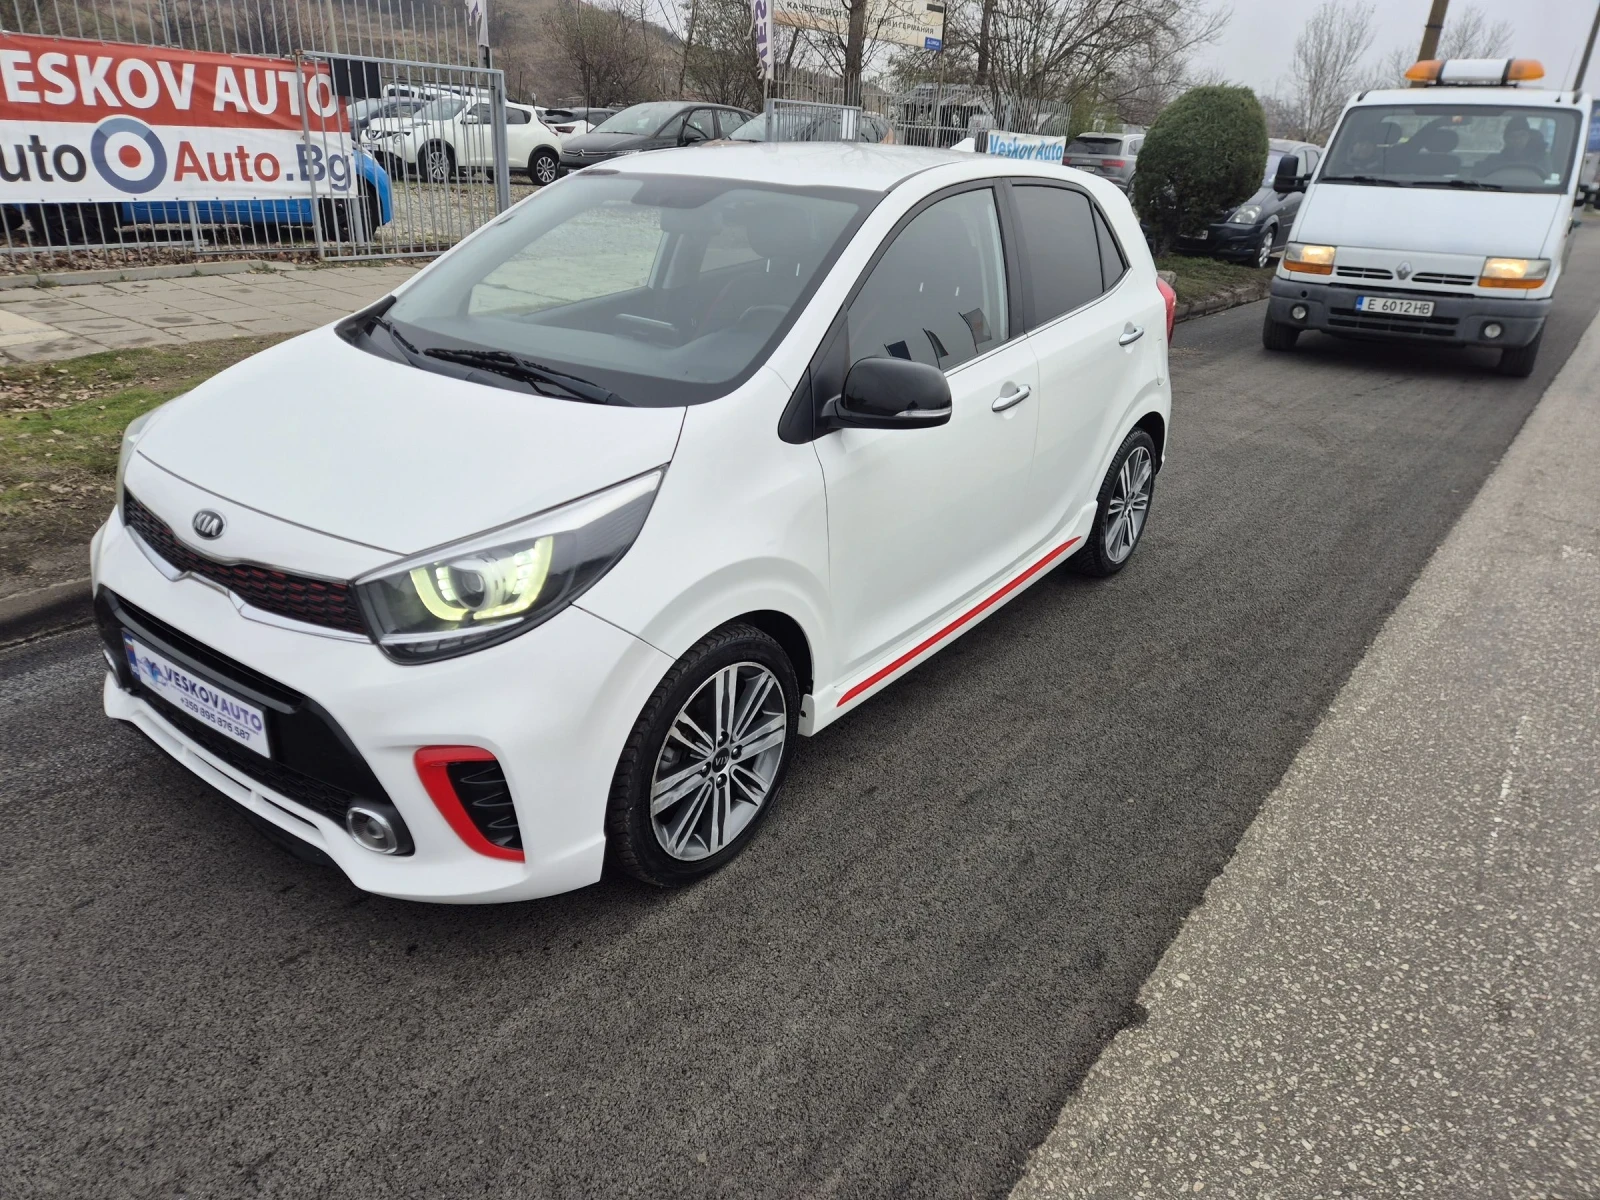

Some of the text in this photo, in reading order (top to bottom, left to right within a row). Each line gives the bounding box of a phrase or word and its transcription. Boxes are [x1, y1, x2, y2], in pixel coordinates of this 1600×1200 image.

[0, 48, 338, 118] ESKOV AUTO
[174, 140, 352, 192] Auto.Bg
[989, 134, 1063, 161] Veskov Auto
[195, 512, 219, 536] KIA
[180, 697, 251, 741] +359 895 876 587
